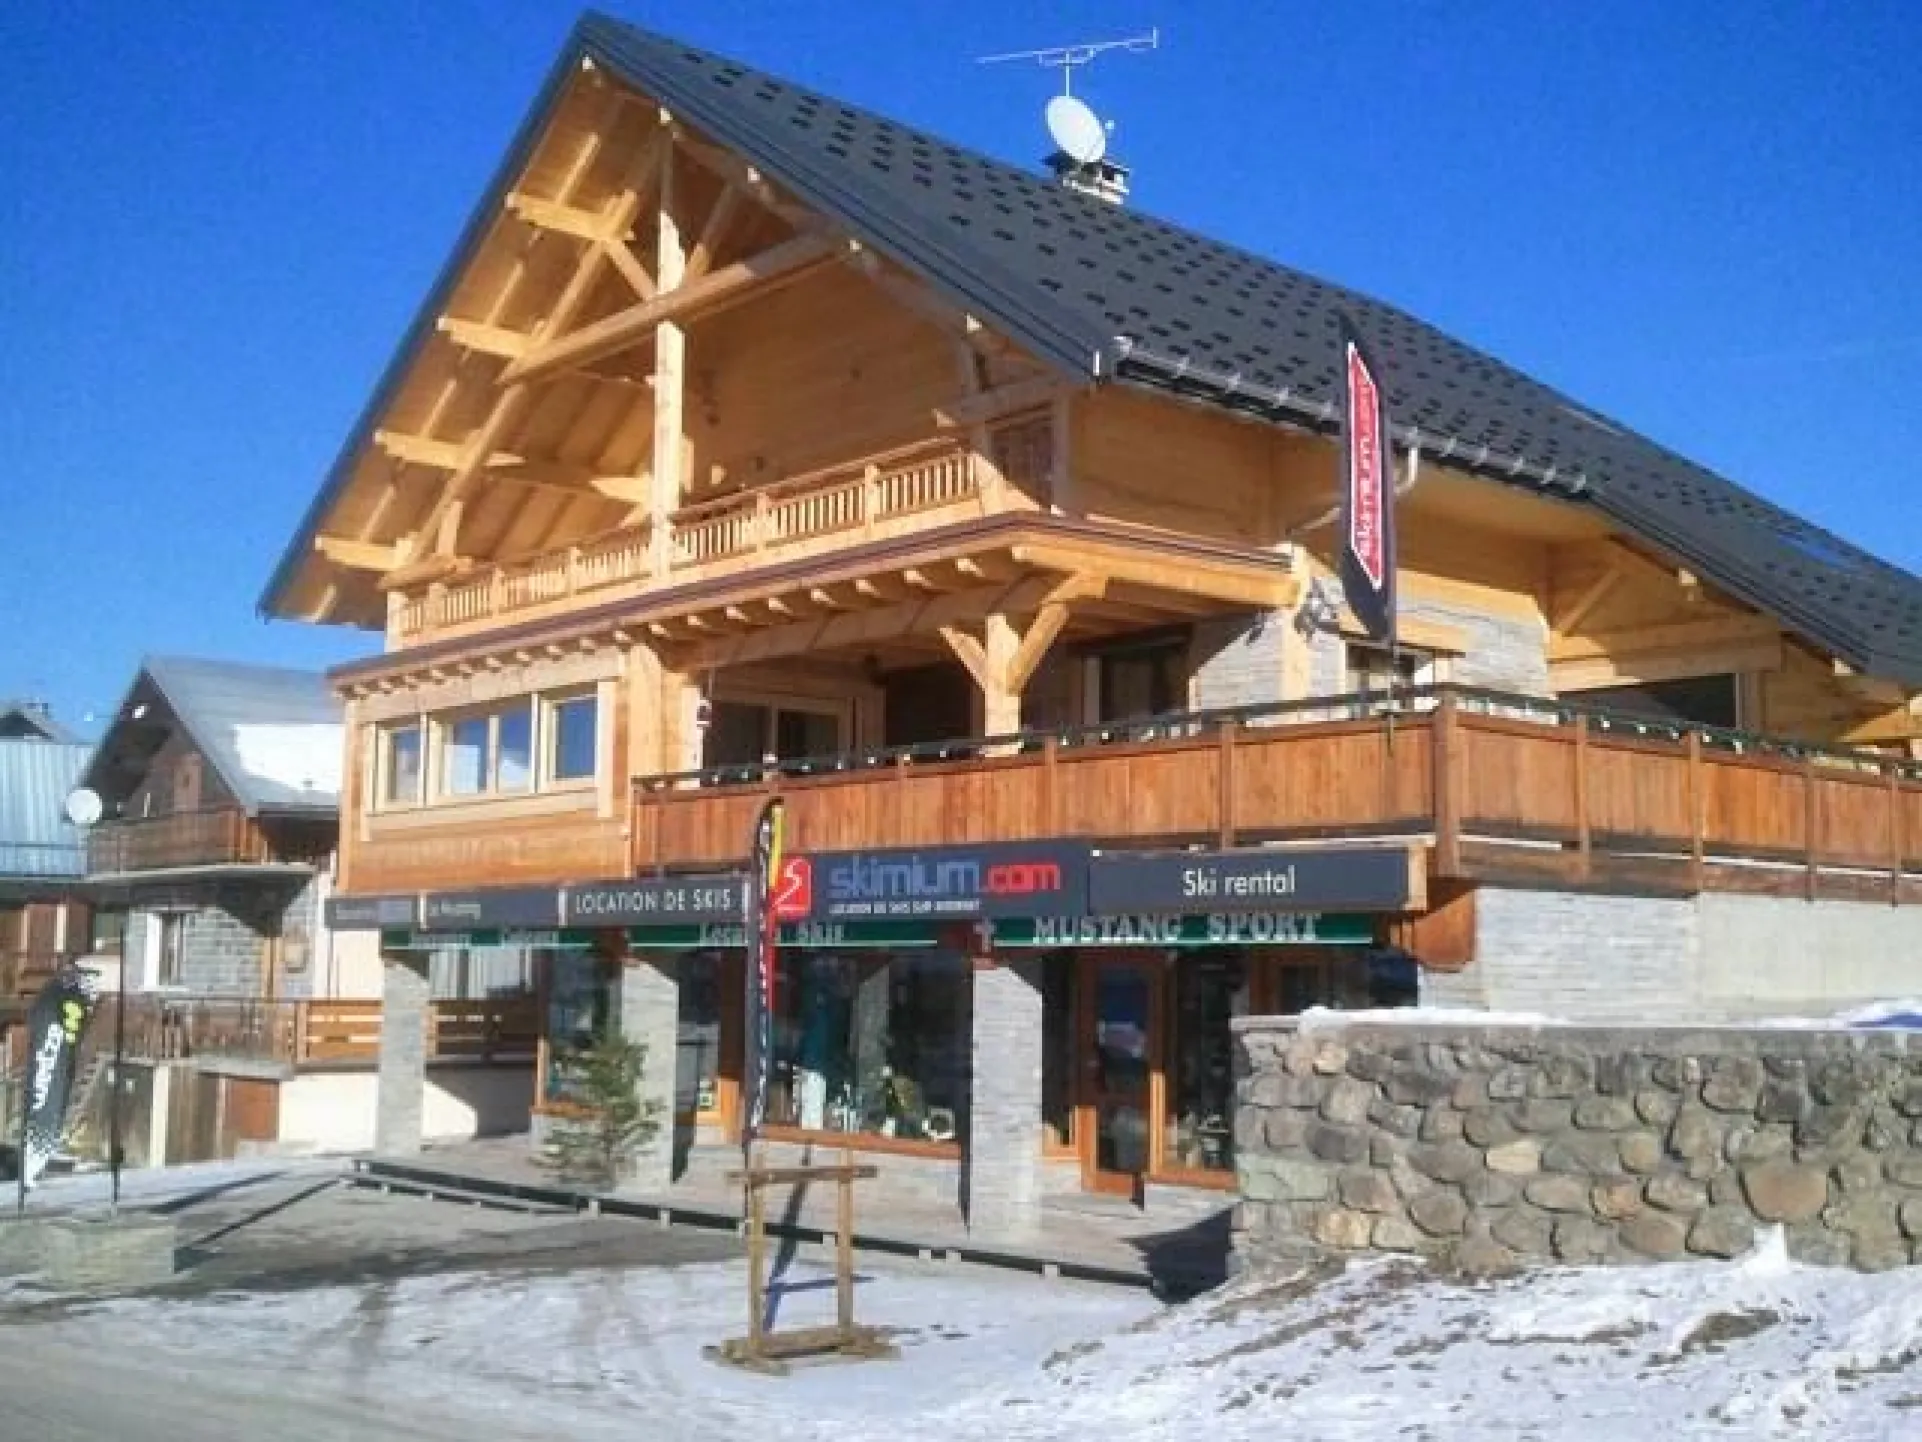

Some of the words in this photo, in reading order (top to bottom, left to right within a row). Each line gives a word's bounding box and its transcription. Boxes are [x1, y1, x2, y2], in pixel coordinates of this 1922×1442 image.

[828, 855, 1062, 899] skimium.com
[1182, 867, 1217, 897] Ski
[1224, 864, 1296, 895] rental
[575, 890, 659, 915] LOCATION
[663, 889, 686, 911] DE
[692, 888, 731, 911] SKIS
[1033, 913, 1183, 942] MUSTANG
[1207, 912, 1321, 941] SPORT
